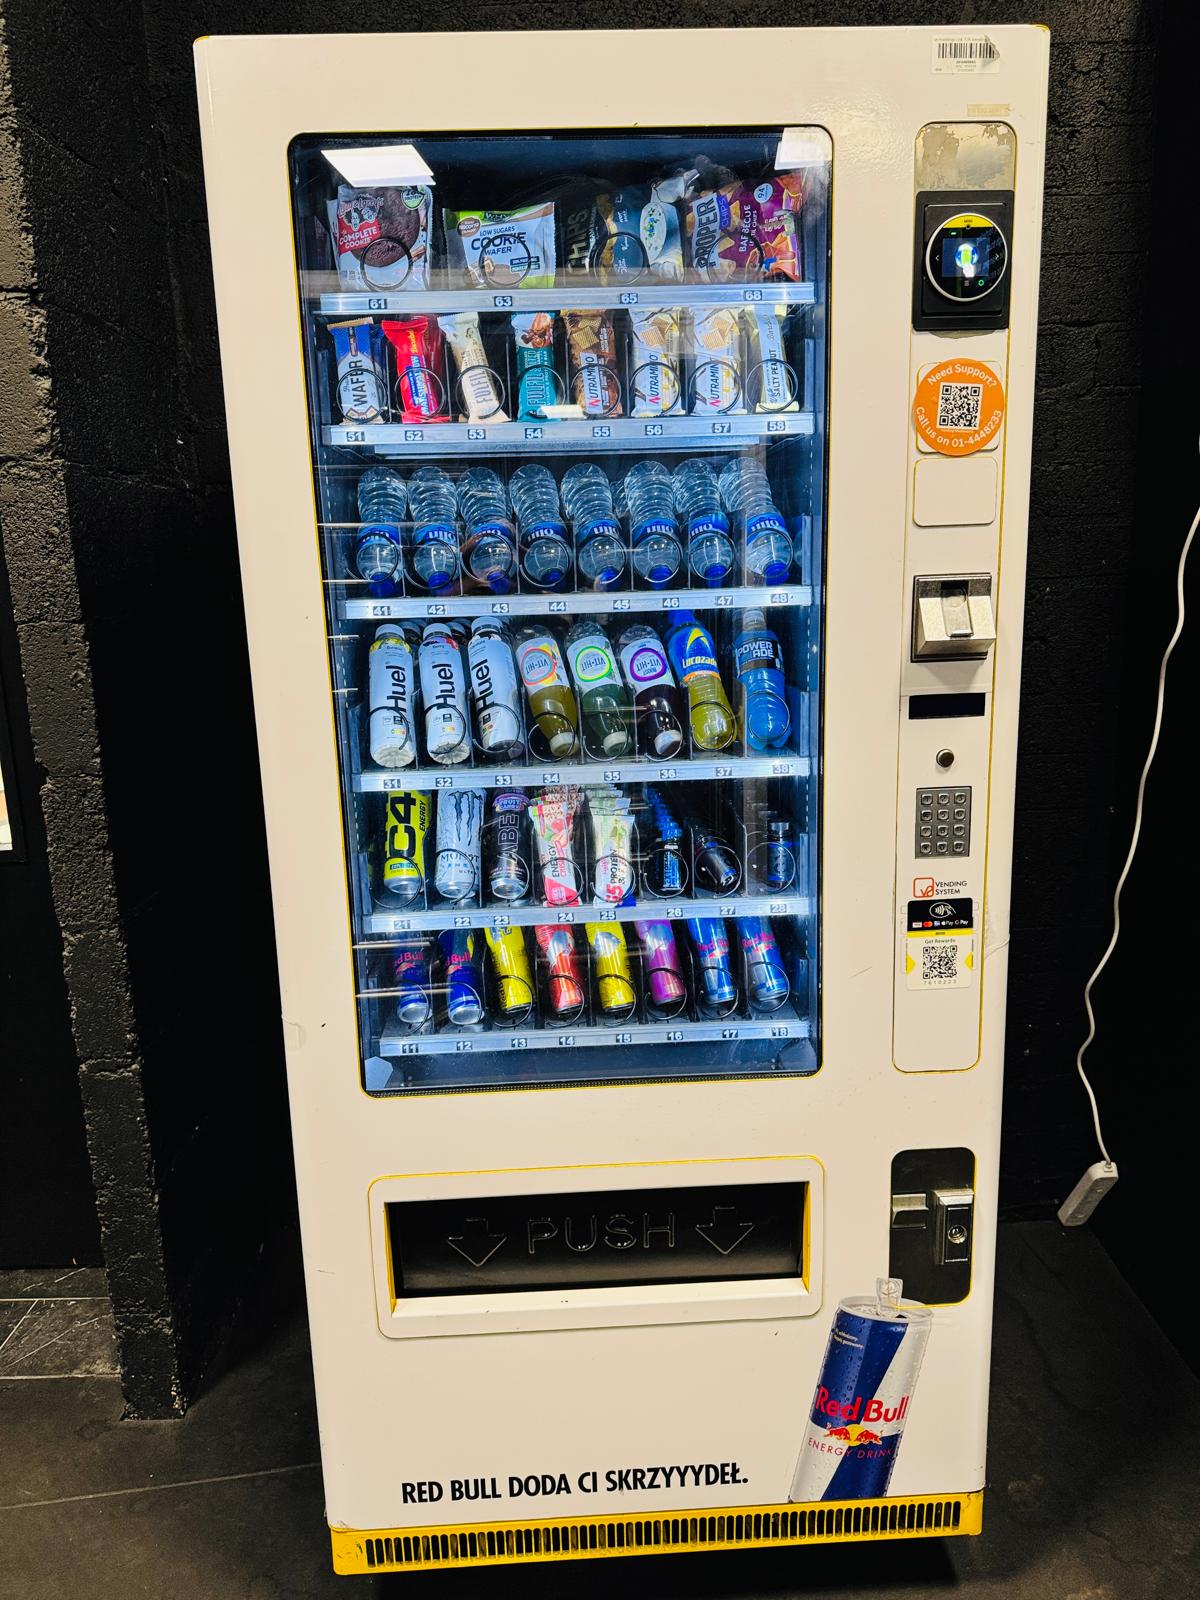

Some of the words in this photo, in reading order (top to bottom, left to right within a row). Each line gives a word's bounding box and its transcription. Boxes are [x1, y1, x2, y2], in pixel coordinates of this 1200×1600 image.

[758, 187, 765, 199] 94
[720, 198, 729, 226] CHIPS
[340, 226, 377, 245] COMPLETE
[480, 229, 492, 237] LOW
[493, 226, 516, 235] SUGARS
[695, 197, 718, 269] PROPER
[345, 237, 372, 249] COOKIE
[471, 232, 527, 251] COOKIE
[484, 246, 512, 256] WAFER
[621, 293, 638, 303] 65
[745, 291, 762, 301] 68
[370, 299, 386, 309] 61
[494, 296, 511, 307] 63
[648, 354, 661, 404] NUTRAMIO
[927, 366, 953, 386] Need
[954, 363, 998, 387] Support?
[349, 359, 368, 407] WAFER
[411, 355, 430, 416] MARSHMALOW
[469, 373, 493, 403] FULFIL
[709, 363, 721, 407] NUTRAMIN
[771, 376, 781, 397] SALTY
[526, 375, 546, 407] FULFIL
[646, 426, 662, 435] 56
[714, 423, 730, 432] 57
[768, 421, 785, 431] 58
[916, 406, 929, 428] Call
[925, 428, 937, 439] us
[936, 436, 949, 446] on
[951, 410, 1002, 447] 01-4448233
[348, 432, 363, 441] 51
[406, 431, 422, 440] 52
[468, 430, 485, 439] 53
[526, 428, 542, 438] 54
[593, 427, 610, 437] 55
[663, 598, 679, 607] 46
[717, 596, 732, 605] 47
[772, 594, 788, 603] 48
[428, 605, 444, 614] 42
[493, 603, 508, 613] 43
[551, 602, 566, 611] 44
[614, 600, 630, 609] 45
[374, 606, 388, 615] 41
[737, 640, 773, 657] POWER
[752, 649, 774, 658] ADE
[385, 665, 407, 712] Huel
[432, 663, 456, 710] Huel
[471, 658, 495, 713] Huel
[661, 769, 676, 778] 36
[716, 767, 732, 776] 37
[773, 764, 789, 774] 38
[496, 776, 512, 785] 33
[543, 774, 559, 783] 34
[605, 771, 620, 780] 35
[385, 779, 399, 788] 31
[436, 777, 452, 787] 32
[419, 800, 427, 832] ENERGY
[389, 791, 416, 857] C4
[548, 844, 560, 878] ENERGY
[610, 848, 618, 884] PROTEN
[935, 880, 968, 888] VENDING
[935, 888, 961, 896] SYSTEM
[667, 908, 682, 917] 26
[720, 906, 735, 915] 27
[771, 904, 787, 913] 28
[494, 916, 510, 925] 23
[558, 913, 574, 922] 24
[601, 911, 615, 920] 25
[395, 920, 409, 929] 21
[455, 917, 470, 926] 22
[404, 952, 424, 961] Bull
[668, 1032, 683, 1041] 16
[723, 1030, 738, 1038] 17
[772, 1028, 788, 1036] 18
[512, 1038, 527, 1048] 13
[559, 1037, 574, 1045] 14
[617, 1034, 631, 1042] 15
[403, 1044, 417, 1053] 11
[457, 1042, 472, 1050] 12
[527, 1212, 675, 1254] PUSH
[815, 1385, 862, 1422] Red
[863, 1396, 910, 1423] Bull
[808, 1437, 853, 1457] ENERGY
[857, 1449, 895, 1459] DRINK
[401, 1480, 444, 1504] RED
[450, 1477, 502, 1502] BULL
[508, 1473, 572, 1498] DODA
[578, 1471, 598, 1493] CI
[605, 1462, 749, 1493] SKRZYYYDEŁ.
